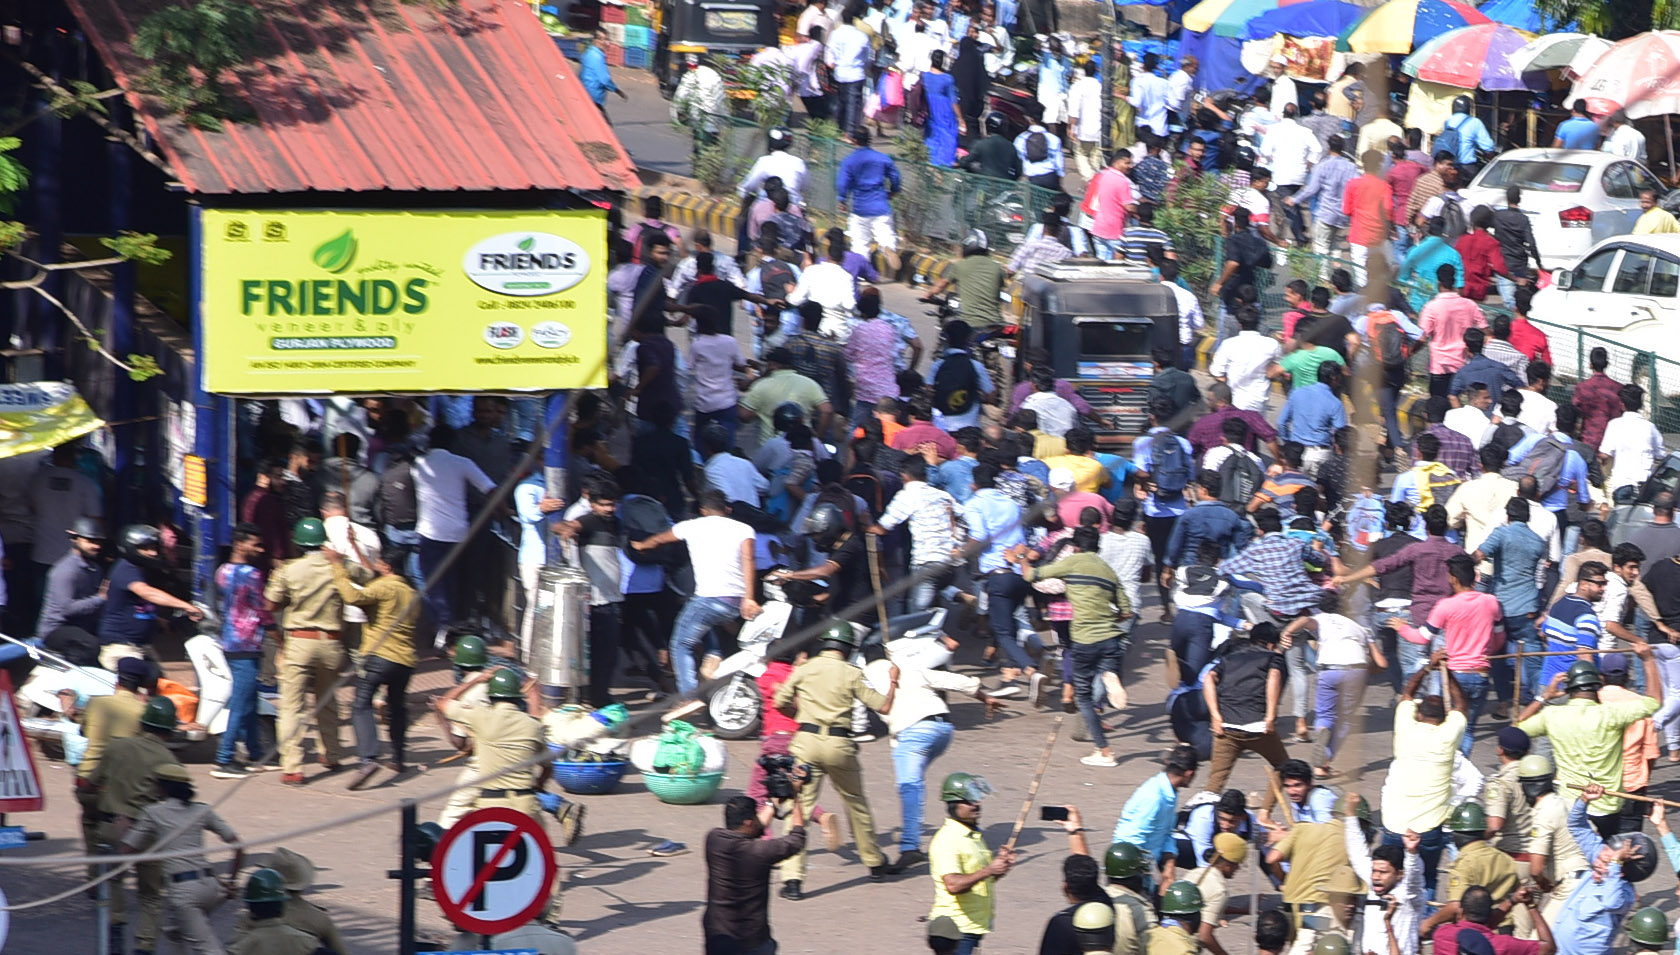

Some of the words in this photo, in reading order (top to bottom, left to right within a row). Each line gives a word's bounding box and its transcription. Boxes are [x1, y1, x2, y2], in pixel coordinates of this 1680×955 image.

[479, 253, 577, 270] FRIENDS
[241, 279, 428, 315] FRIENDS
[256, 322, 344, 333] veneer
[353, 318, 366, 333] &
[378, 318, 415, 334] ply
[331, 337, 395, 348] PLYWOOD
[471, 830, 528, 911] P
